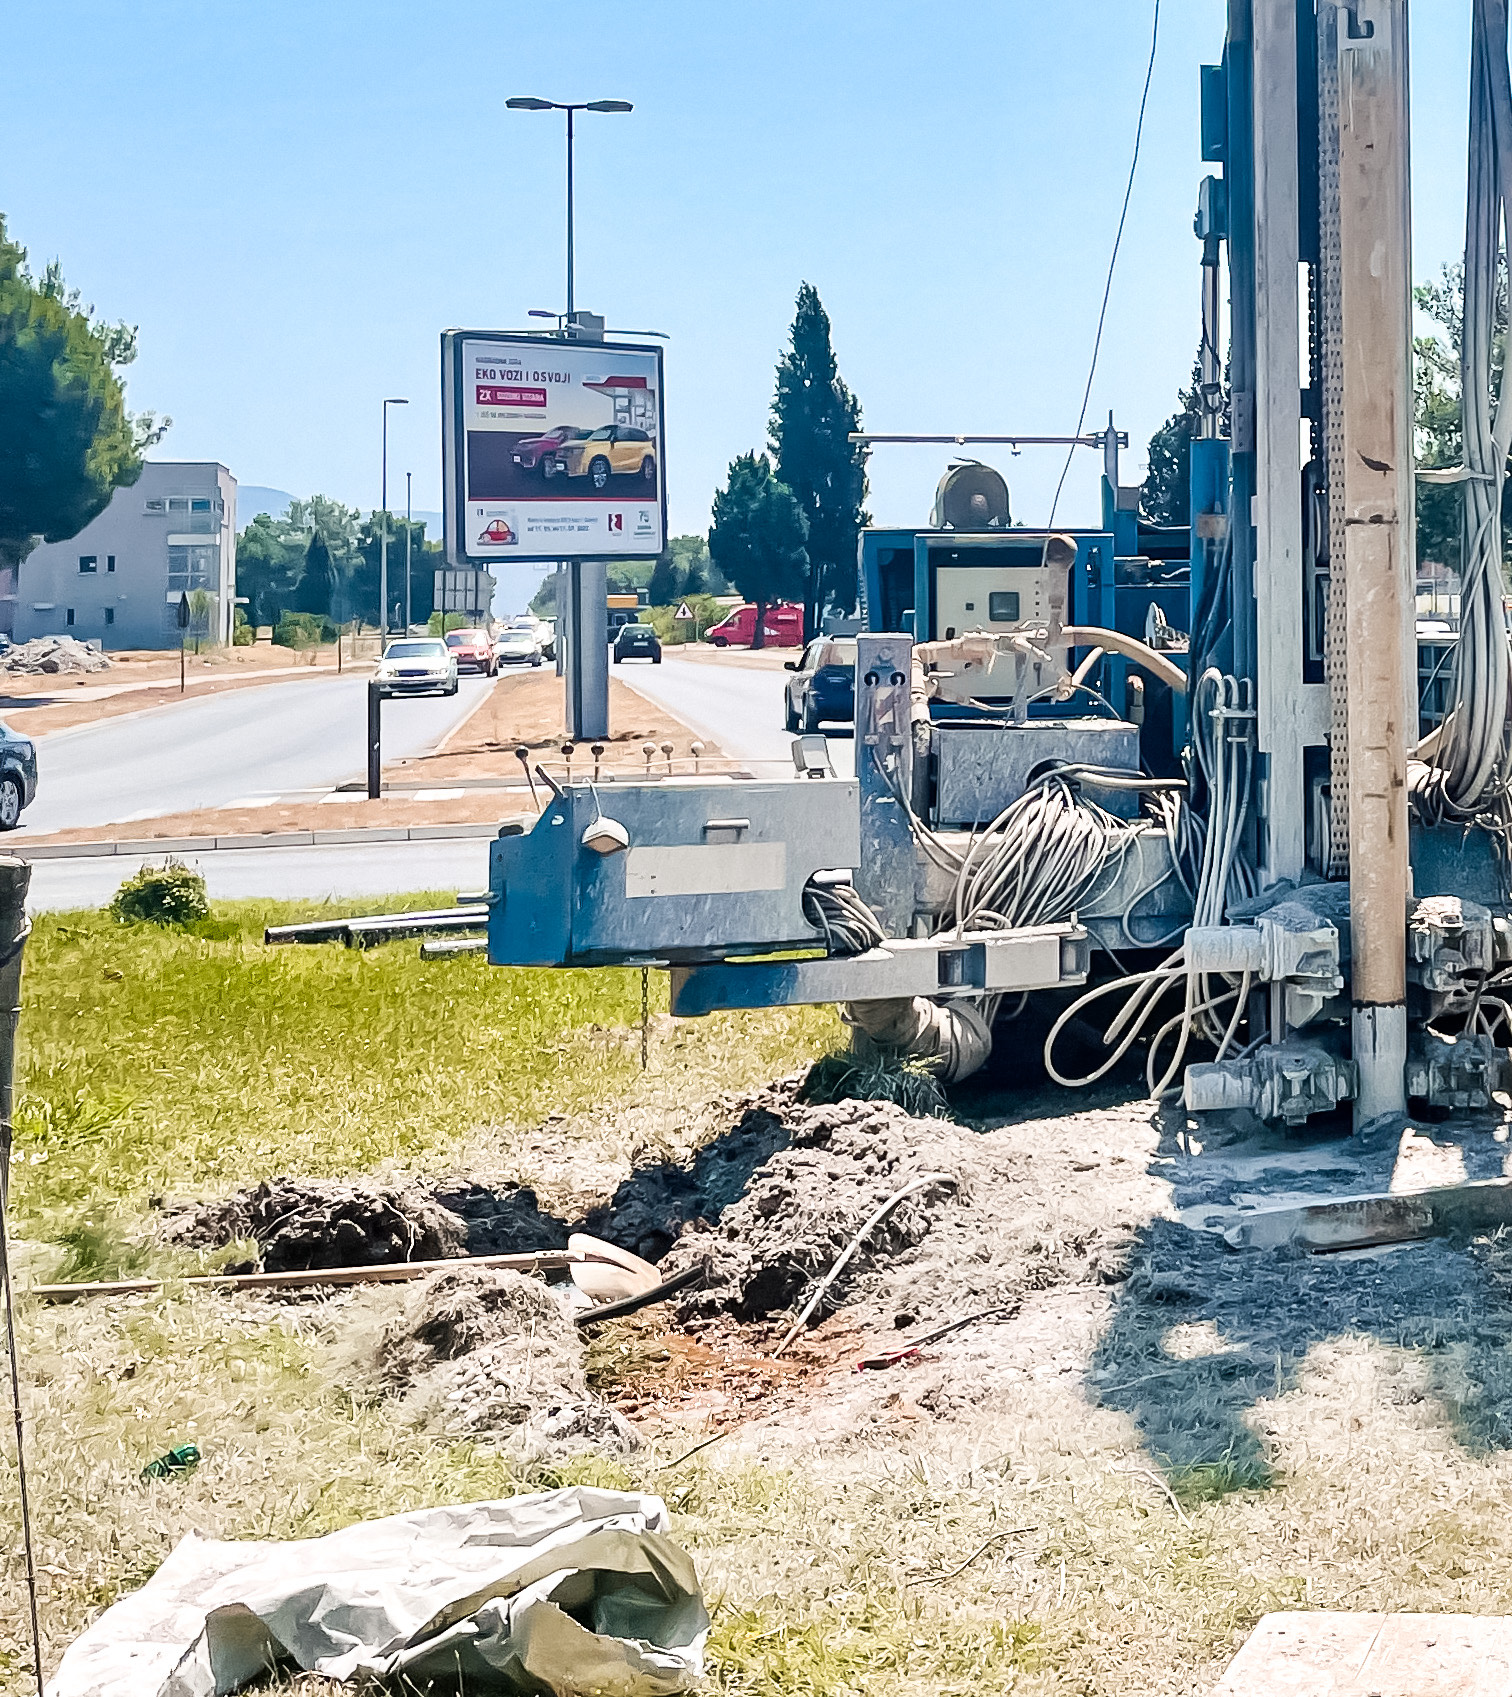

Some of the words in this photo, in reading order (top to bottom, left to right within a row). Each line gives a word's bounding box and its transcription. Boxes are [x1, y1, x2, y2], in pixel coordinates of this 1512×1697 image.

[475, 368, 496, 380] EKO
[499, 369, 522, 382] VOZI
[533, 371, 570, 383] OSVOJI
[479, 389, 491, 401] 2X
